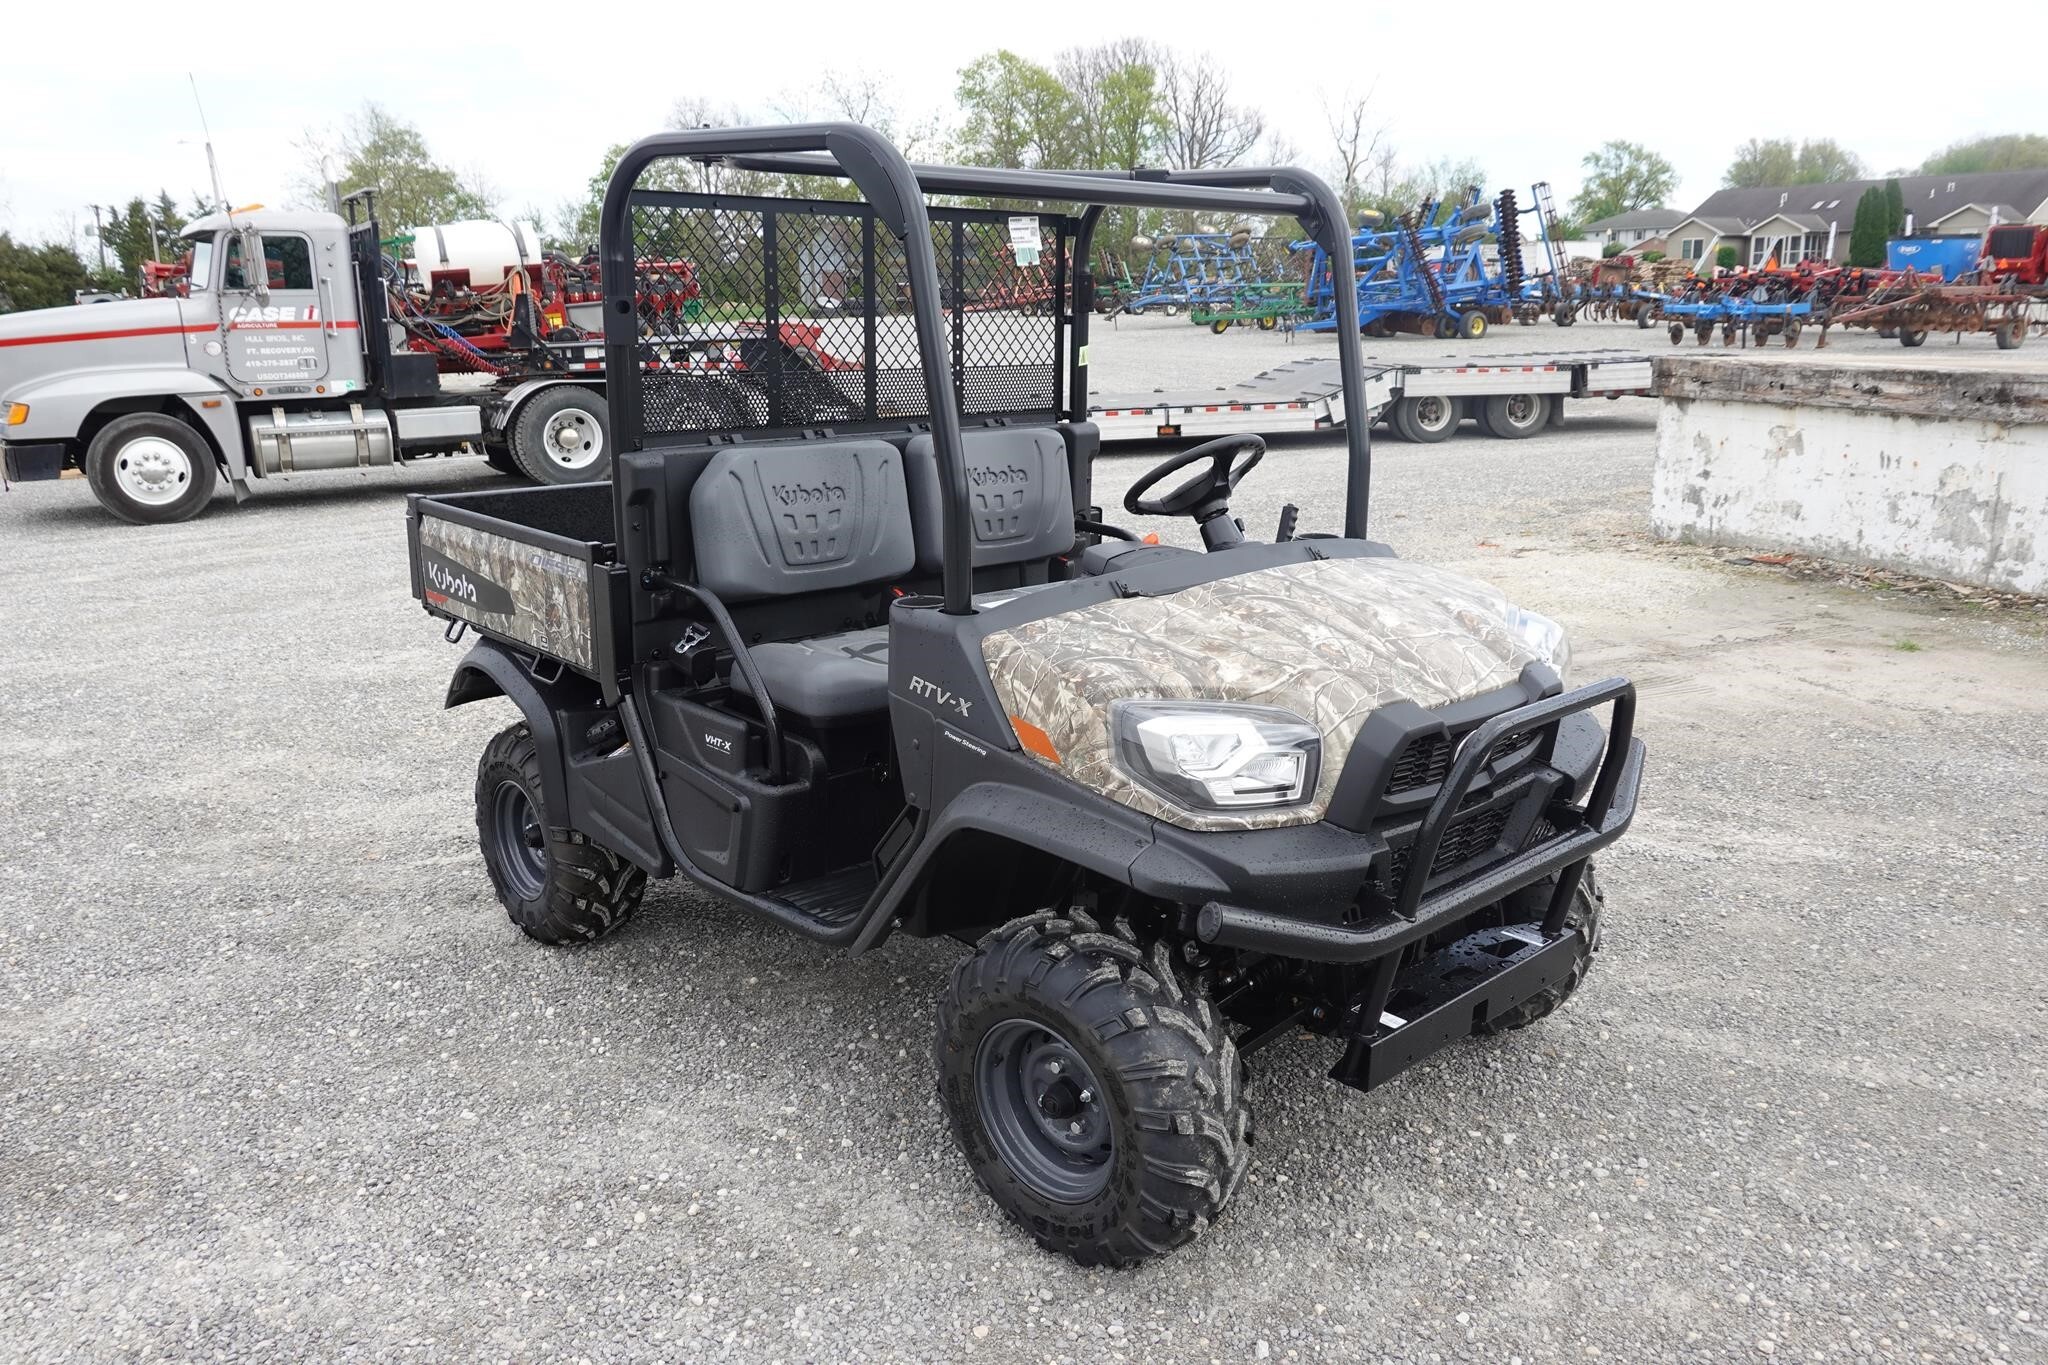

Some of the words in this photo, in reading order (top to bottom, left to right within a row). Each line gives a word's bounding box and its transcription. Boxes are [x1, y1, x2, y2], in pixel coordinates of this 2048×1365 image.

[229, 306, 296, 322] CASE
[245, 335, 263, 343] HULL
[966, 464, 1029, 487] Kubota
[772, 481, 846, 507] Kubota
[428, 561, 477, 603] Kubota
[909, 675, 973, 718] RTV-X
[705, 733, 732, 750] VHT-X
[944, 730, 962, 745] Power
[961, 739, 987, 756] Steering
